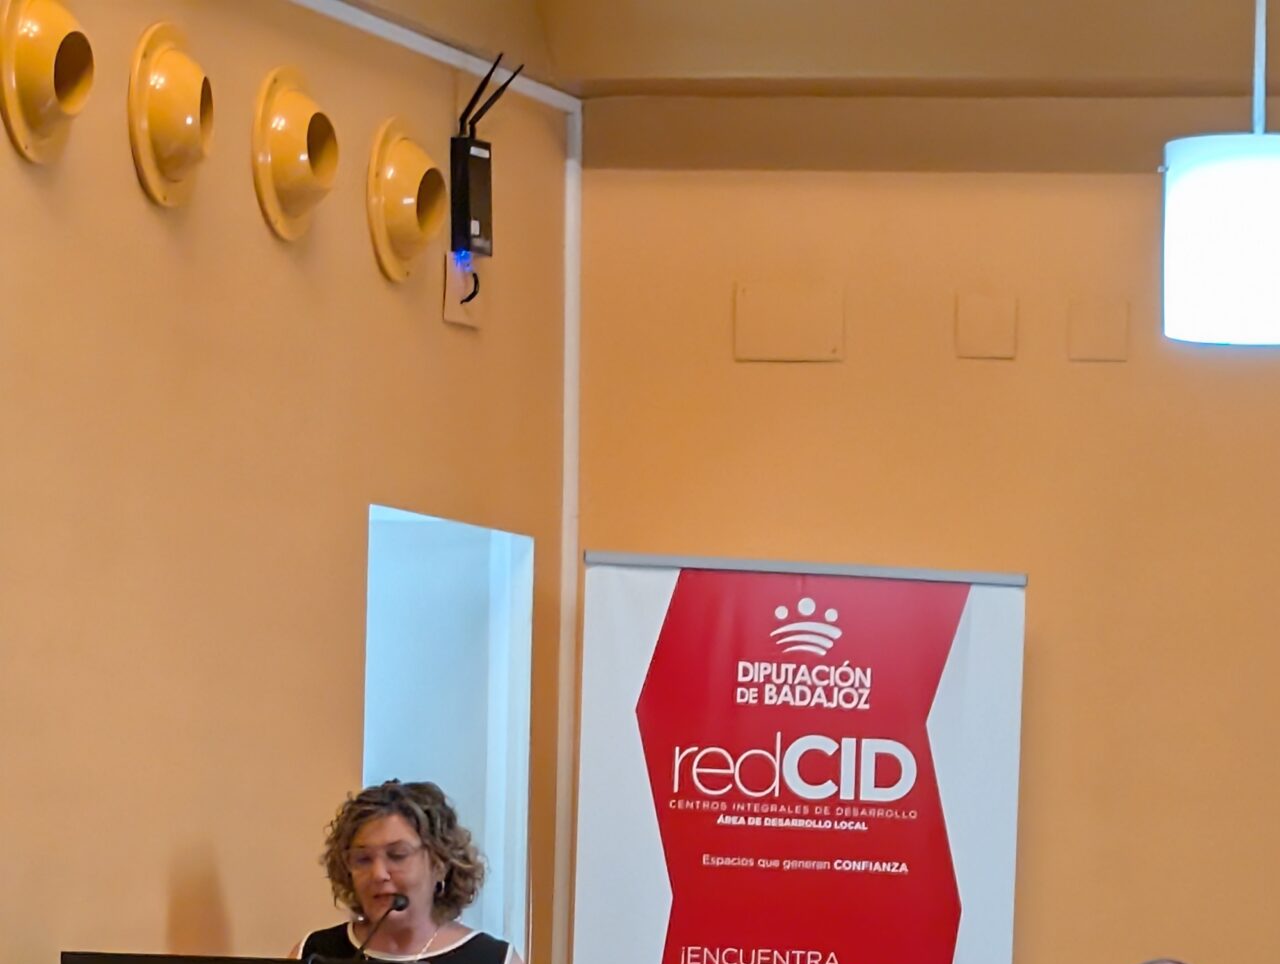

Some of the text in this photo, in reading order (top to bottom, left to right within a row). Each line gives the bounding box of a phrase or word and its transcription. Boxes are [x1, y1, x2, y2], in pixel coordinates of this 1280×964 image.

[736, 660, 872, 688] DIPUTACIÓN
[736, 683, 871, 710] DE BADAJOZ
[672, 731, 918, 802] redCID
[669, 799, 918, 820] CENTROS INTEGRALES DE DESARROLLO
[716, 813, 869, 831] ÁREA DE DESARROLLO LOCAL
[702, 853, 909, 873] Espacios que generan CONFIANZA
